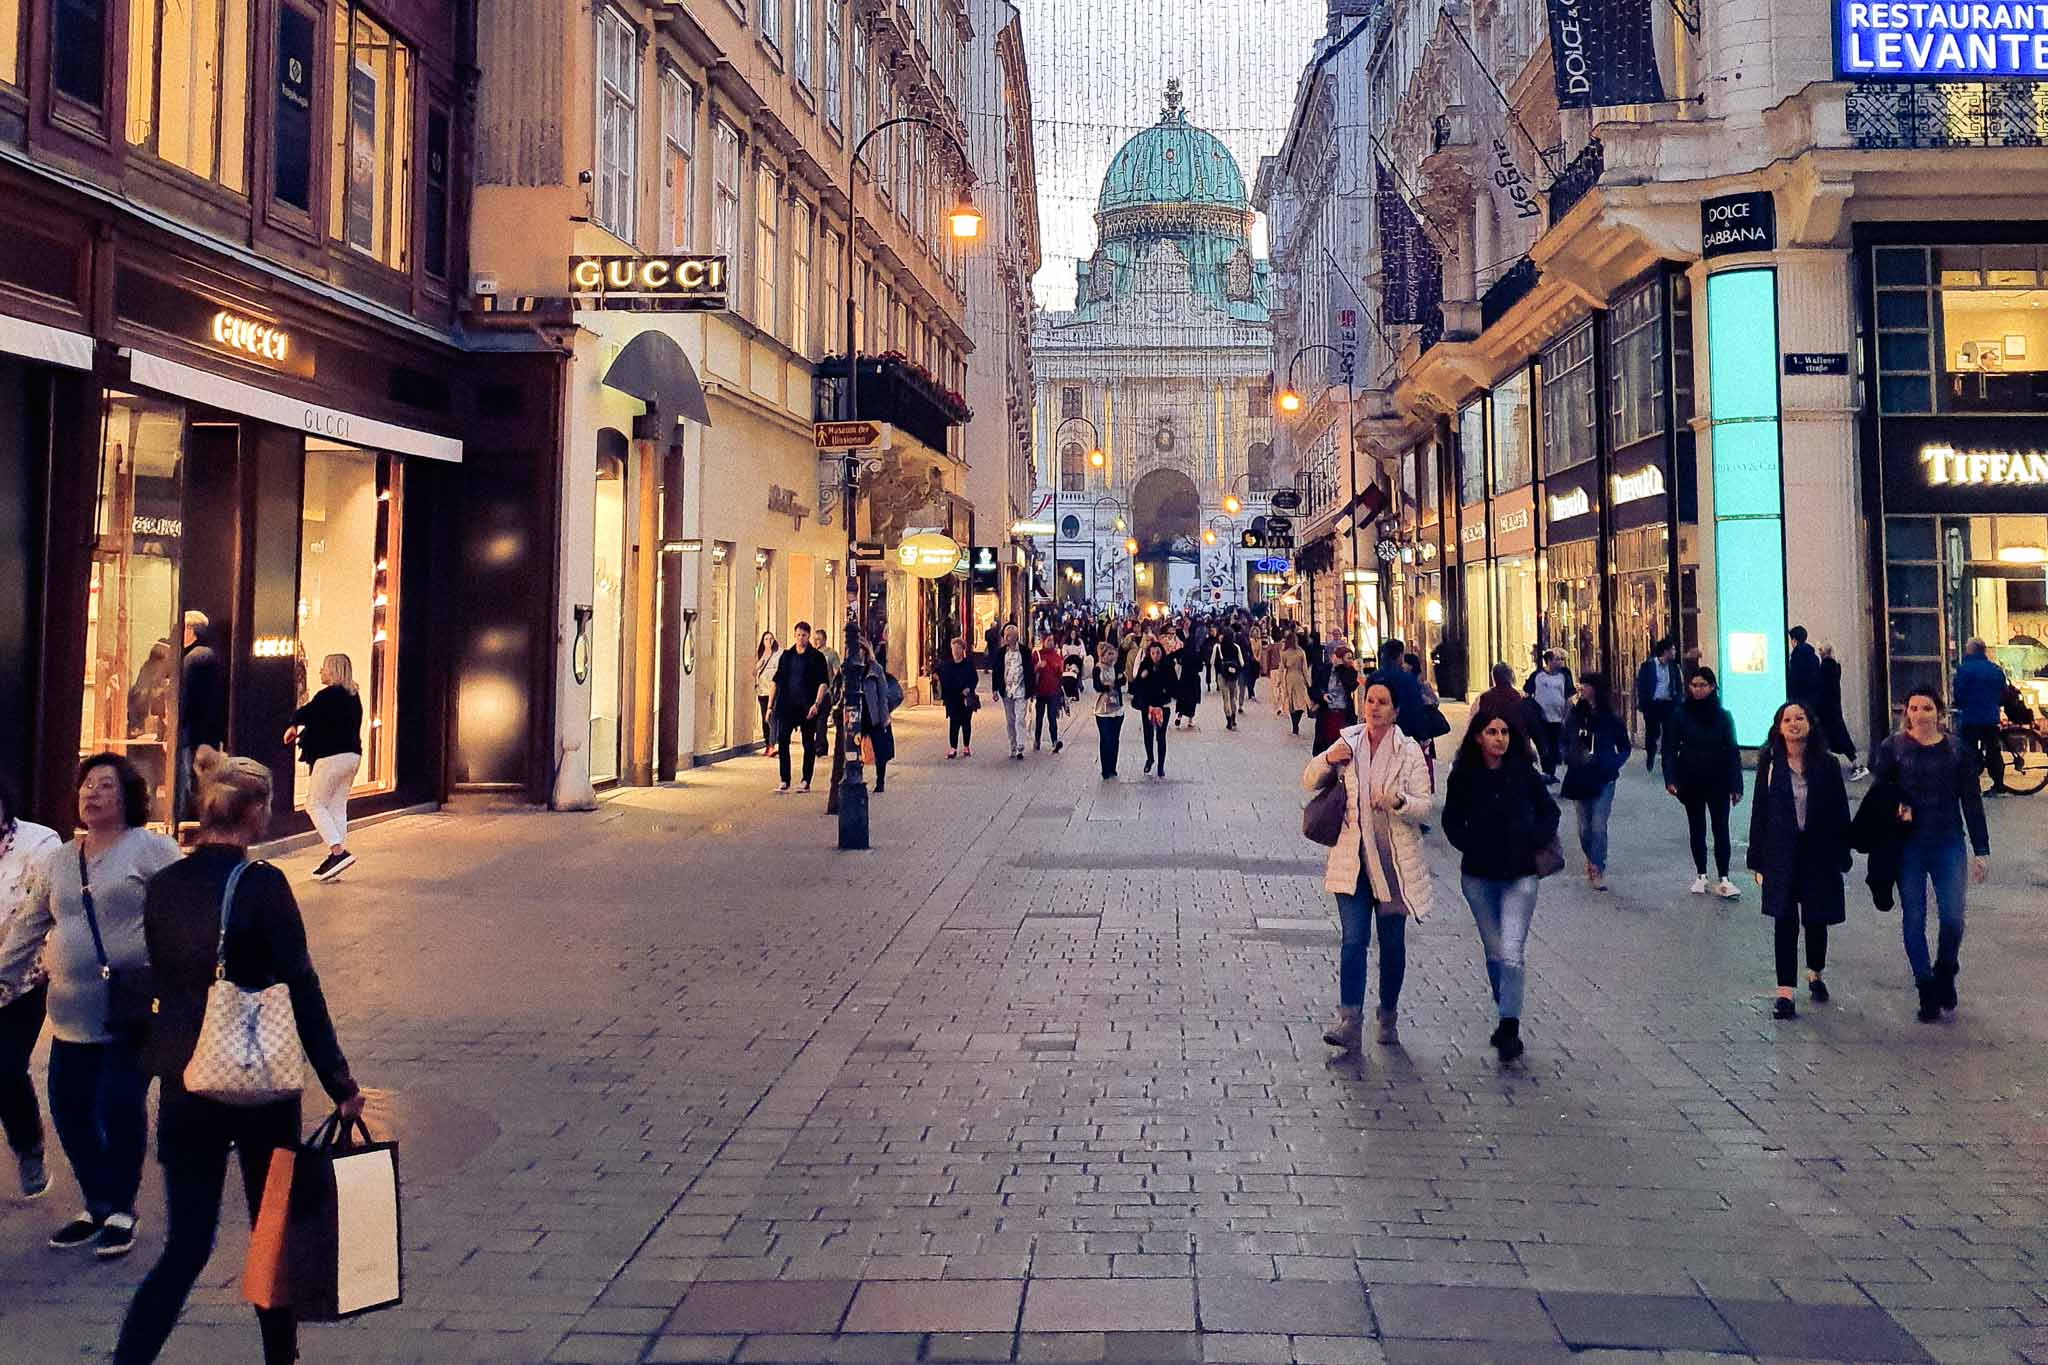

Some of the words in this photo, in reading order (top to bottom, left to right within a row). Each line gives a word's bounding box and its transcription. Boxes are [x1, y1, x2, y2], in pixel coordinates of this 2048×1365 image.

[1851, 4, 2048, 29] RESTAURANT
[1561, 20, 1590, 94] DOLCE
[1852, 32, 2048, 70] LEVANTE
[1709, 203, 1750, 222] DOLCE
[1703, 227, 1766, 248] GABBANA
[575, 260, 721, 288] GUCCI
[212, 311, 289, 361] GUCCI
